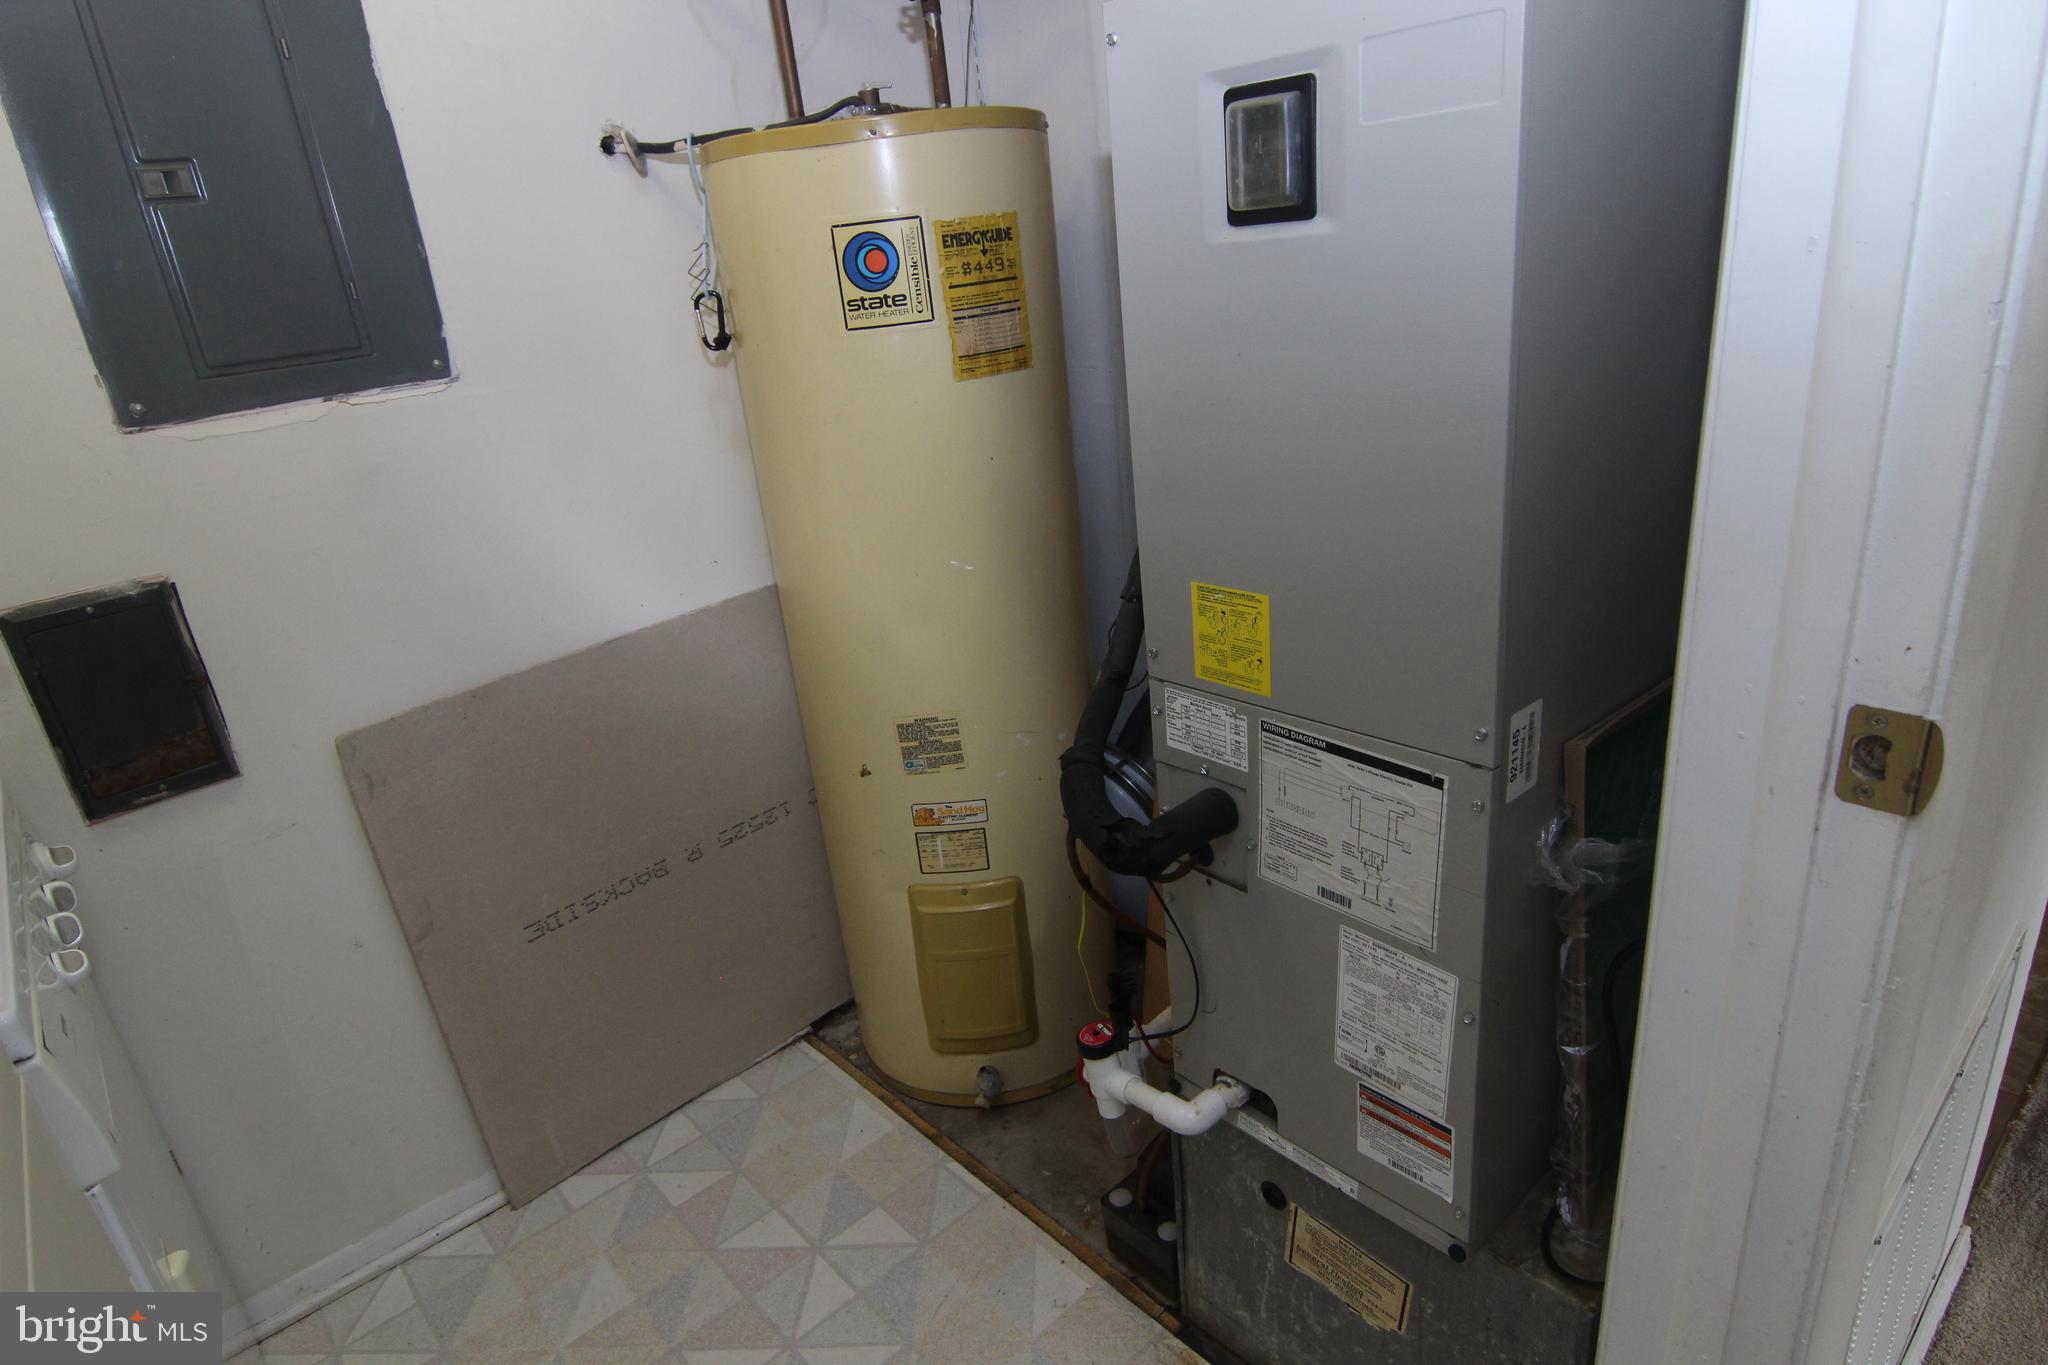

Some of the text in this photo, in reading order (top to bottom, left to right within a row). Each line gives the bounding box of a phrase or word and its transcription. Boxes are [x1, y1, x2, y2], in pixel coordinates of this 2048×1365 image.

[962, 258, 1005, 276] $449
[911, 257, 923, 314] Censible
[847, 293, 908, 313] state
[849, 308, 910, 322] WATER HEATER
[1262, 721, 1290, 738] WIRING
[1290, 730, 1327, 749] DIAGRAM
[522, 858, 671, 944] BACKSIDE
